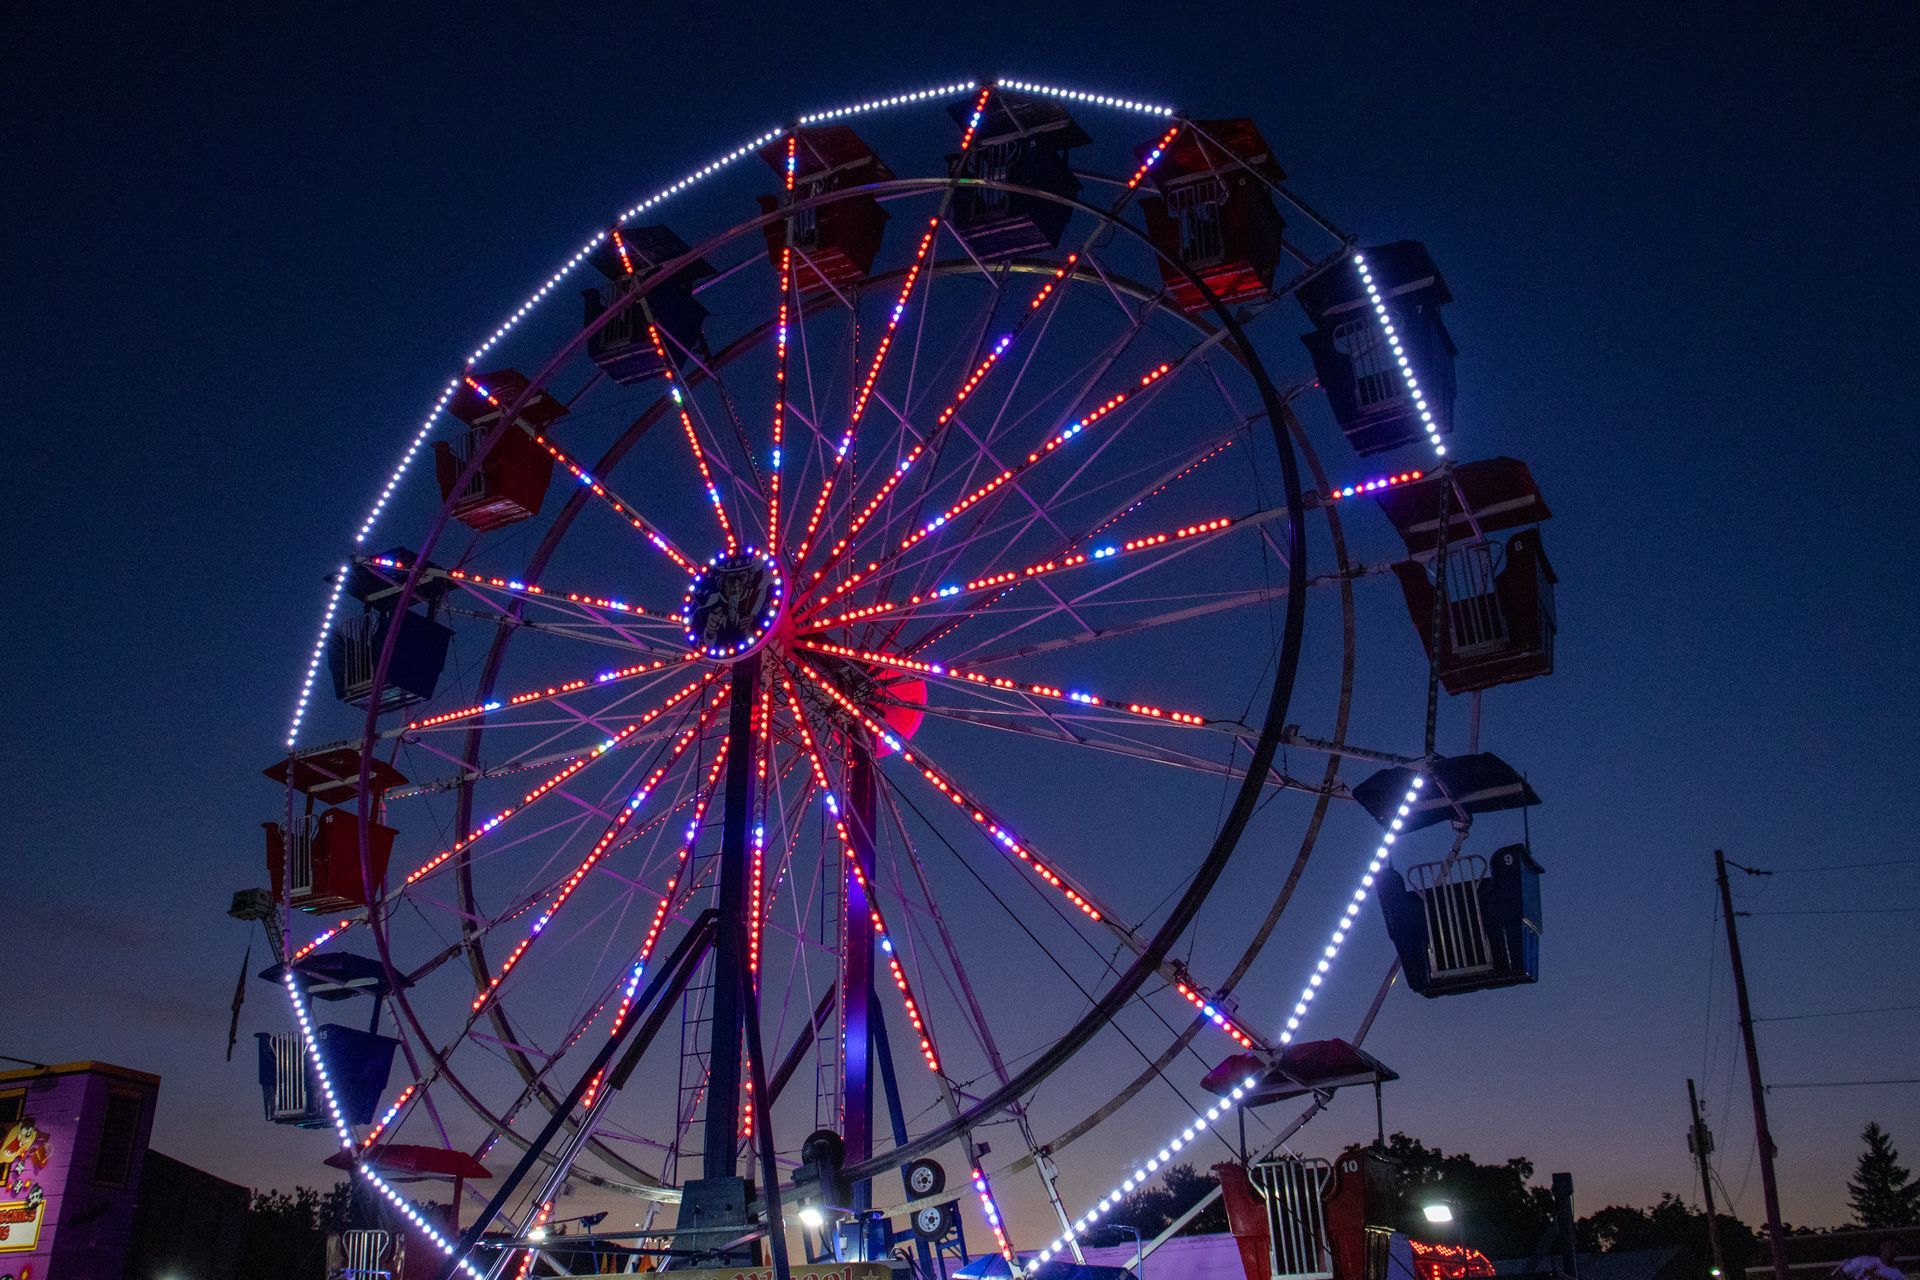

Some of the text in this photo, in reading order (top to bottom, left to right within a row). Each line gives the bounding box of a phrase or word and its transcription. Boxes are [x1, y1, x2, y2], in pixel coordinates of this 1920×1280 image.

[1514, 541, 1523, 551] 8
[1504, 854, 1513, 865] 9
[1342, 1160, 1359, 1173] 10
